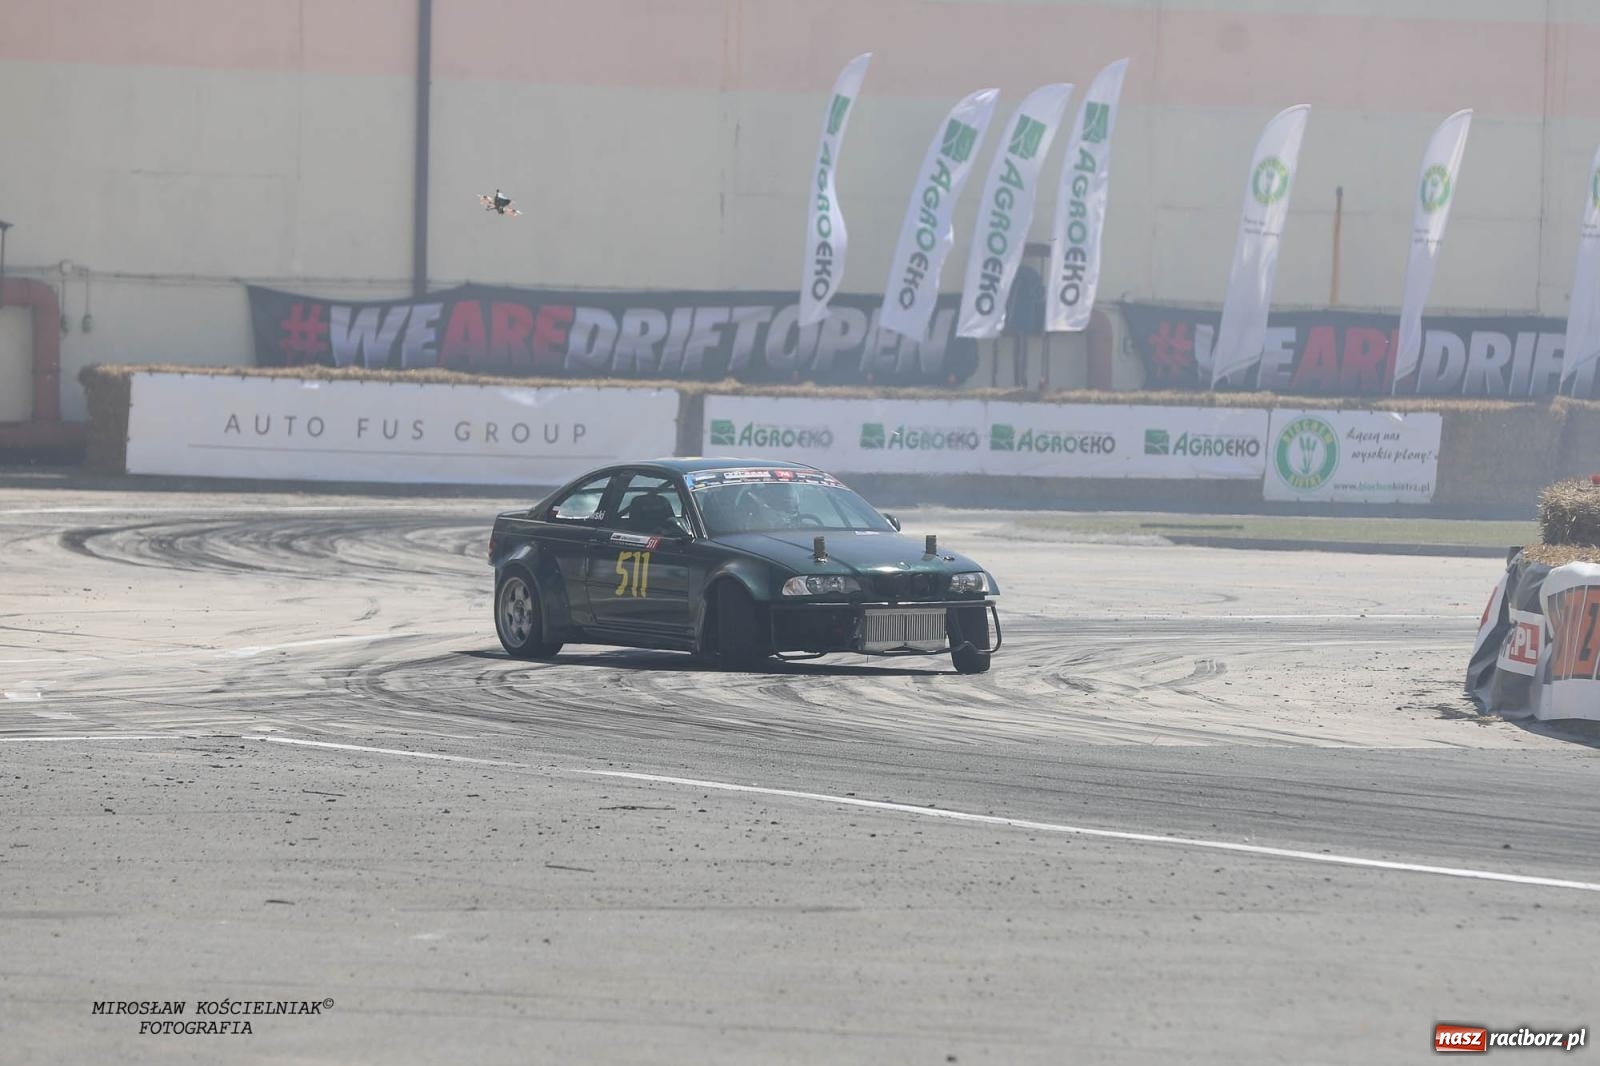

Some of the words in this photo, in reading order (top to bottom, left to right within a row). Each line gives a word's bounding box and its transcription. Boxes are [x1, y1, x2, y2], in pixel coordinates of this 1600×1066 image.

[811, 141, 833, 302] AGROEKO
[898, 158, 952, 311] AGROEKO
[975, 157, 1025, 316] AGROEKO
[1059, 147, 1097, 306] AGROEKO
[224, 413, 326, 437] AUTO
[356, 418, 425, 440] FUS
[454, 421, 587, 445] GROUP
[738, 421, 834, 448] AGROEKO
[888, 425, 981, 450] AGROEKO
[1017, 428, 1117, 455] AGROEKO
[1173, 431, 1260, 457] AGROEKO
[615, 551, 651, 598] 511
